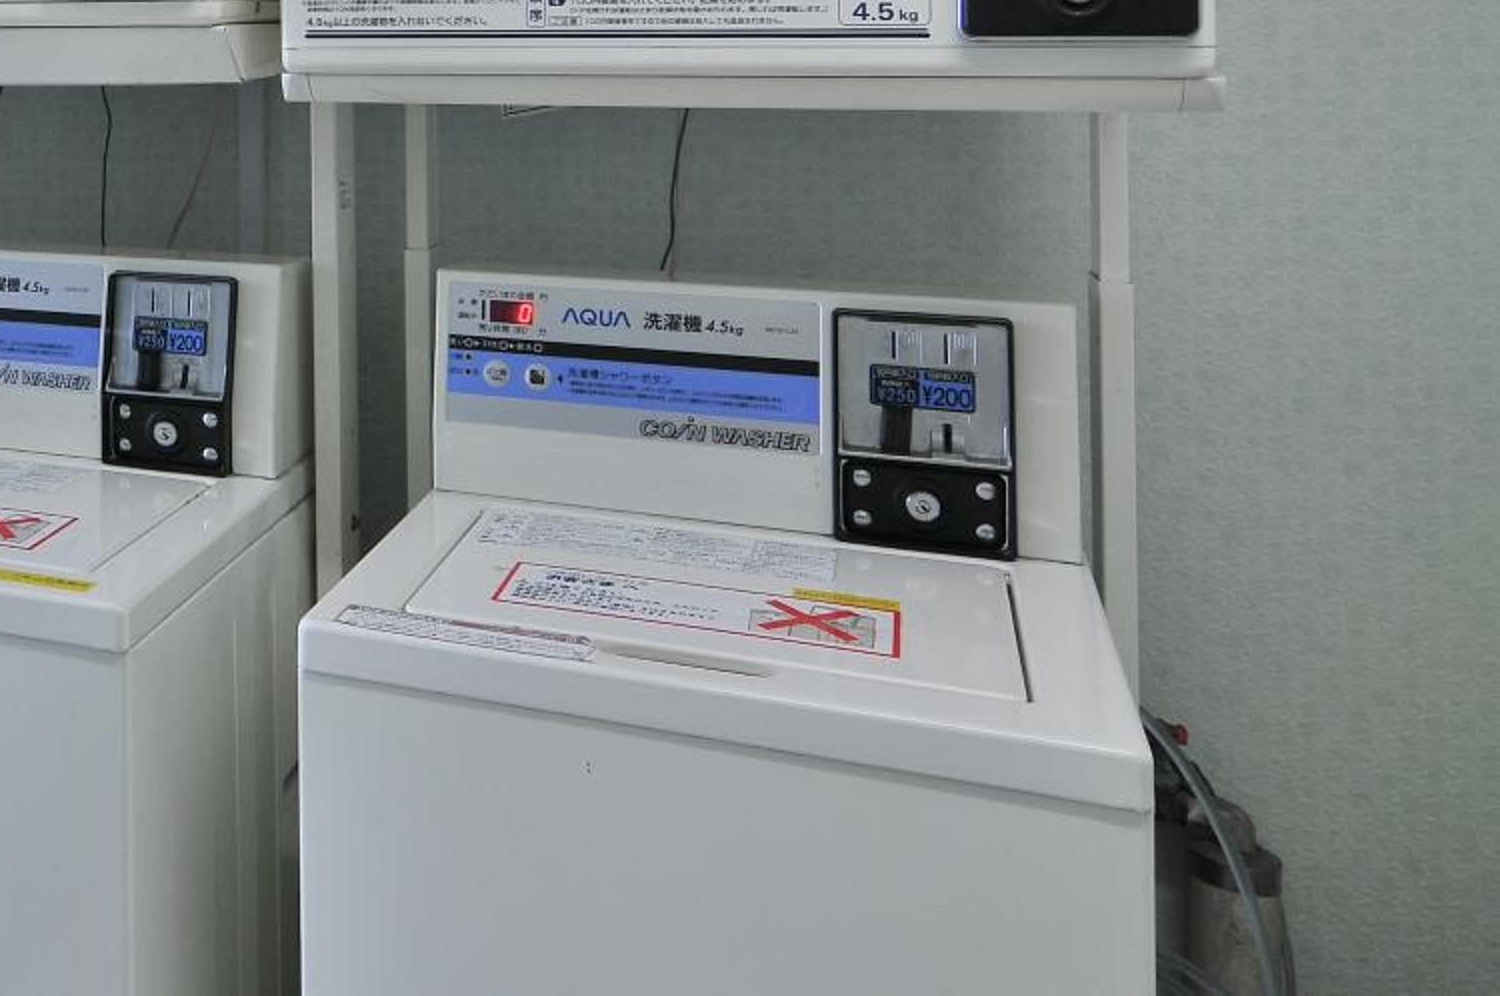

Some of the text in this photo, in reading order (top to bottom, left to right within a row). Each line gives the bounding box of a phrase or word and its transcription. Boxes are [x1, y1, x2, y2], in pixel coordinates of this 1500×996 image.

[852, 1, 919, 23] 4.5 kg
[22, 280, 50, 296] 4.5kg
[516, 302, 533, 324] 0
[561, 307, 632, 329] AQUA
[643, 311, 703, 335] 洗濯機
[705, 319, 745, 338] 4.5kg
[922, 385, 972, 409] ¥200
[710, 424, 812, 453] WASHER
